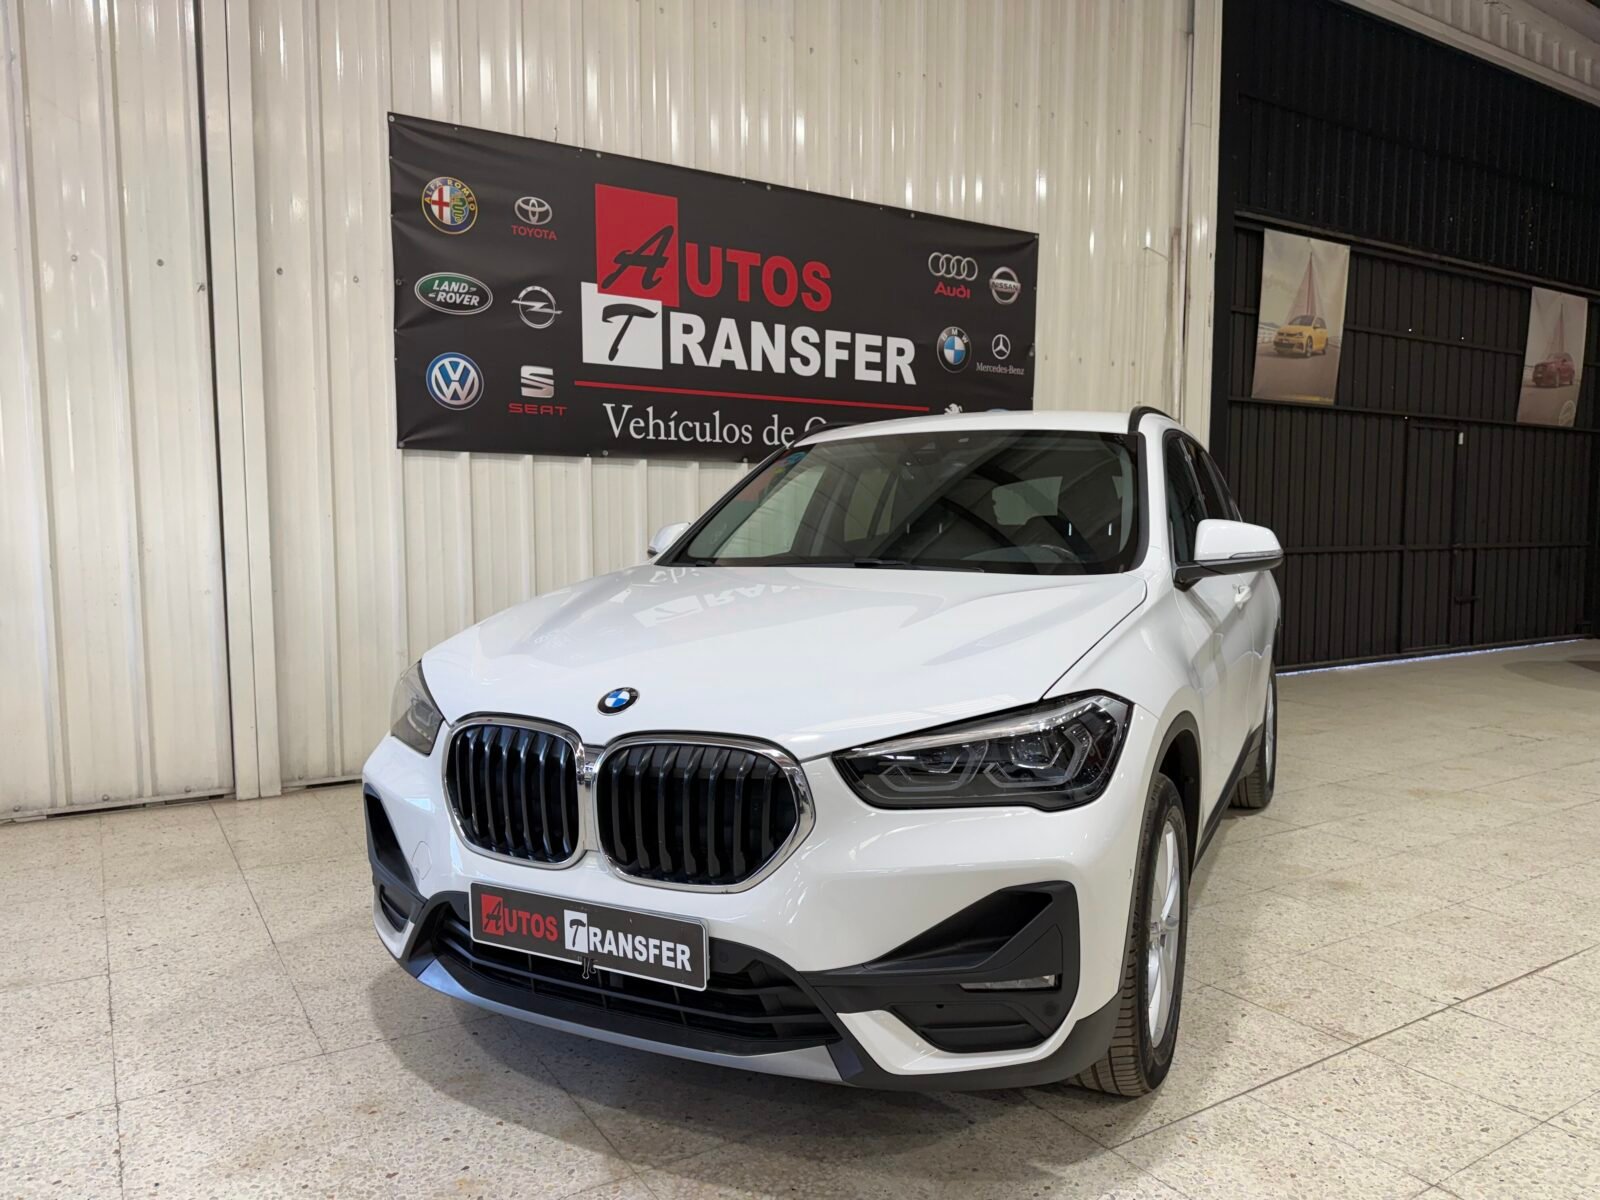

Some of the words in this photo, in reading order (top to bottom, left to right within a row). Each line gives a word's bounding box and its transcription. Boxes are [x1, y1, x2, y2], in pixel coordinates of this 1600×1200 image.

[448, 179, 476, 211] ROMEO
[511, 224, 557, 240] TOYOTA
[601, 225, 832, 312] AUTOS
[433, 280, 469, 293] LAND
[934, 281, 971, 299] Audi
[991, 281, 1019, 291] NISSAN
[437, 291, 480, 306] ROVER
[602, 303, 917, 385] TRANSFER
[941, 328, 969, 345] BMW
[976, 362, 1025, 375] Mercedes-Benz
[508, 403, 568, 416] SEAT
[602, 403, 753, 445] Vehículos
[762, 414, 795, 446] de
[484, 902, 559, 942] AUTOS
[568, 918, 692, 972] TRANSFER
